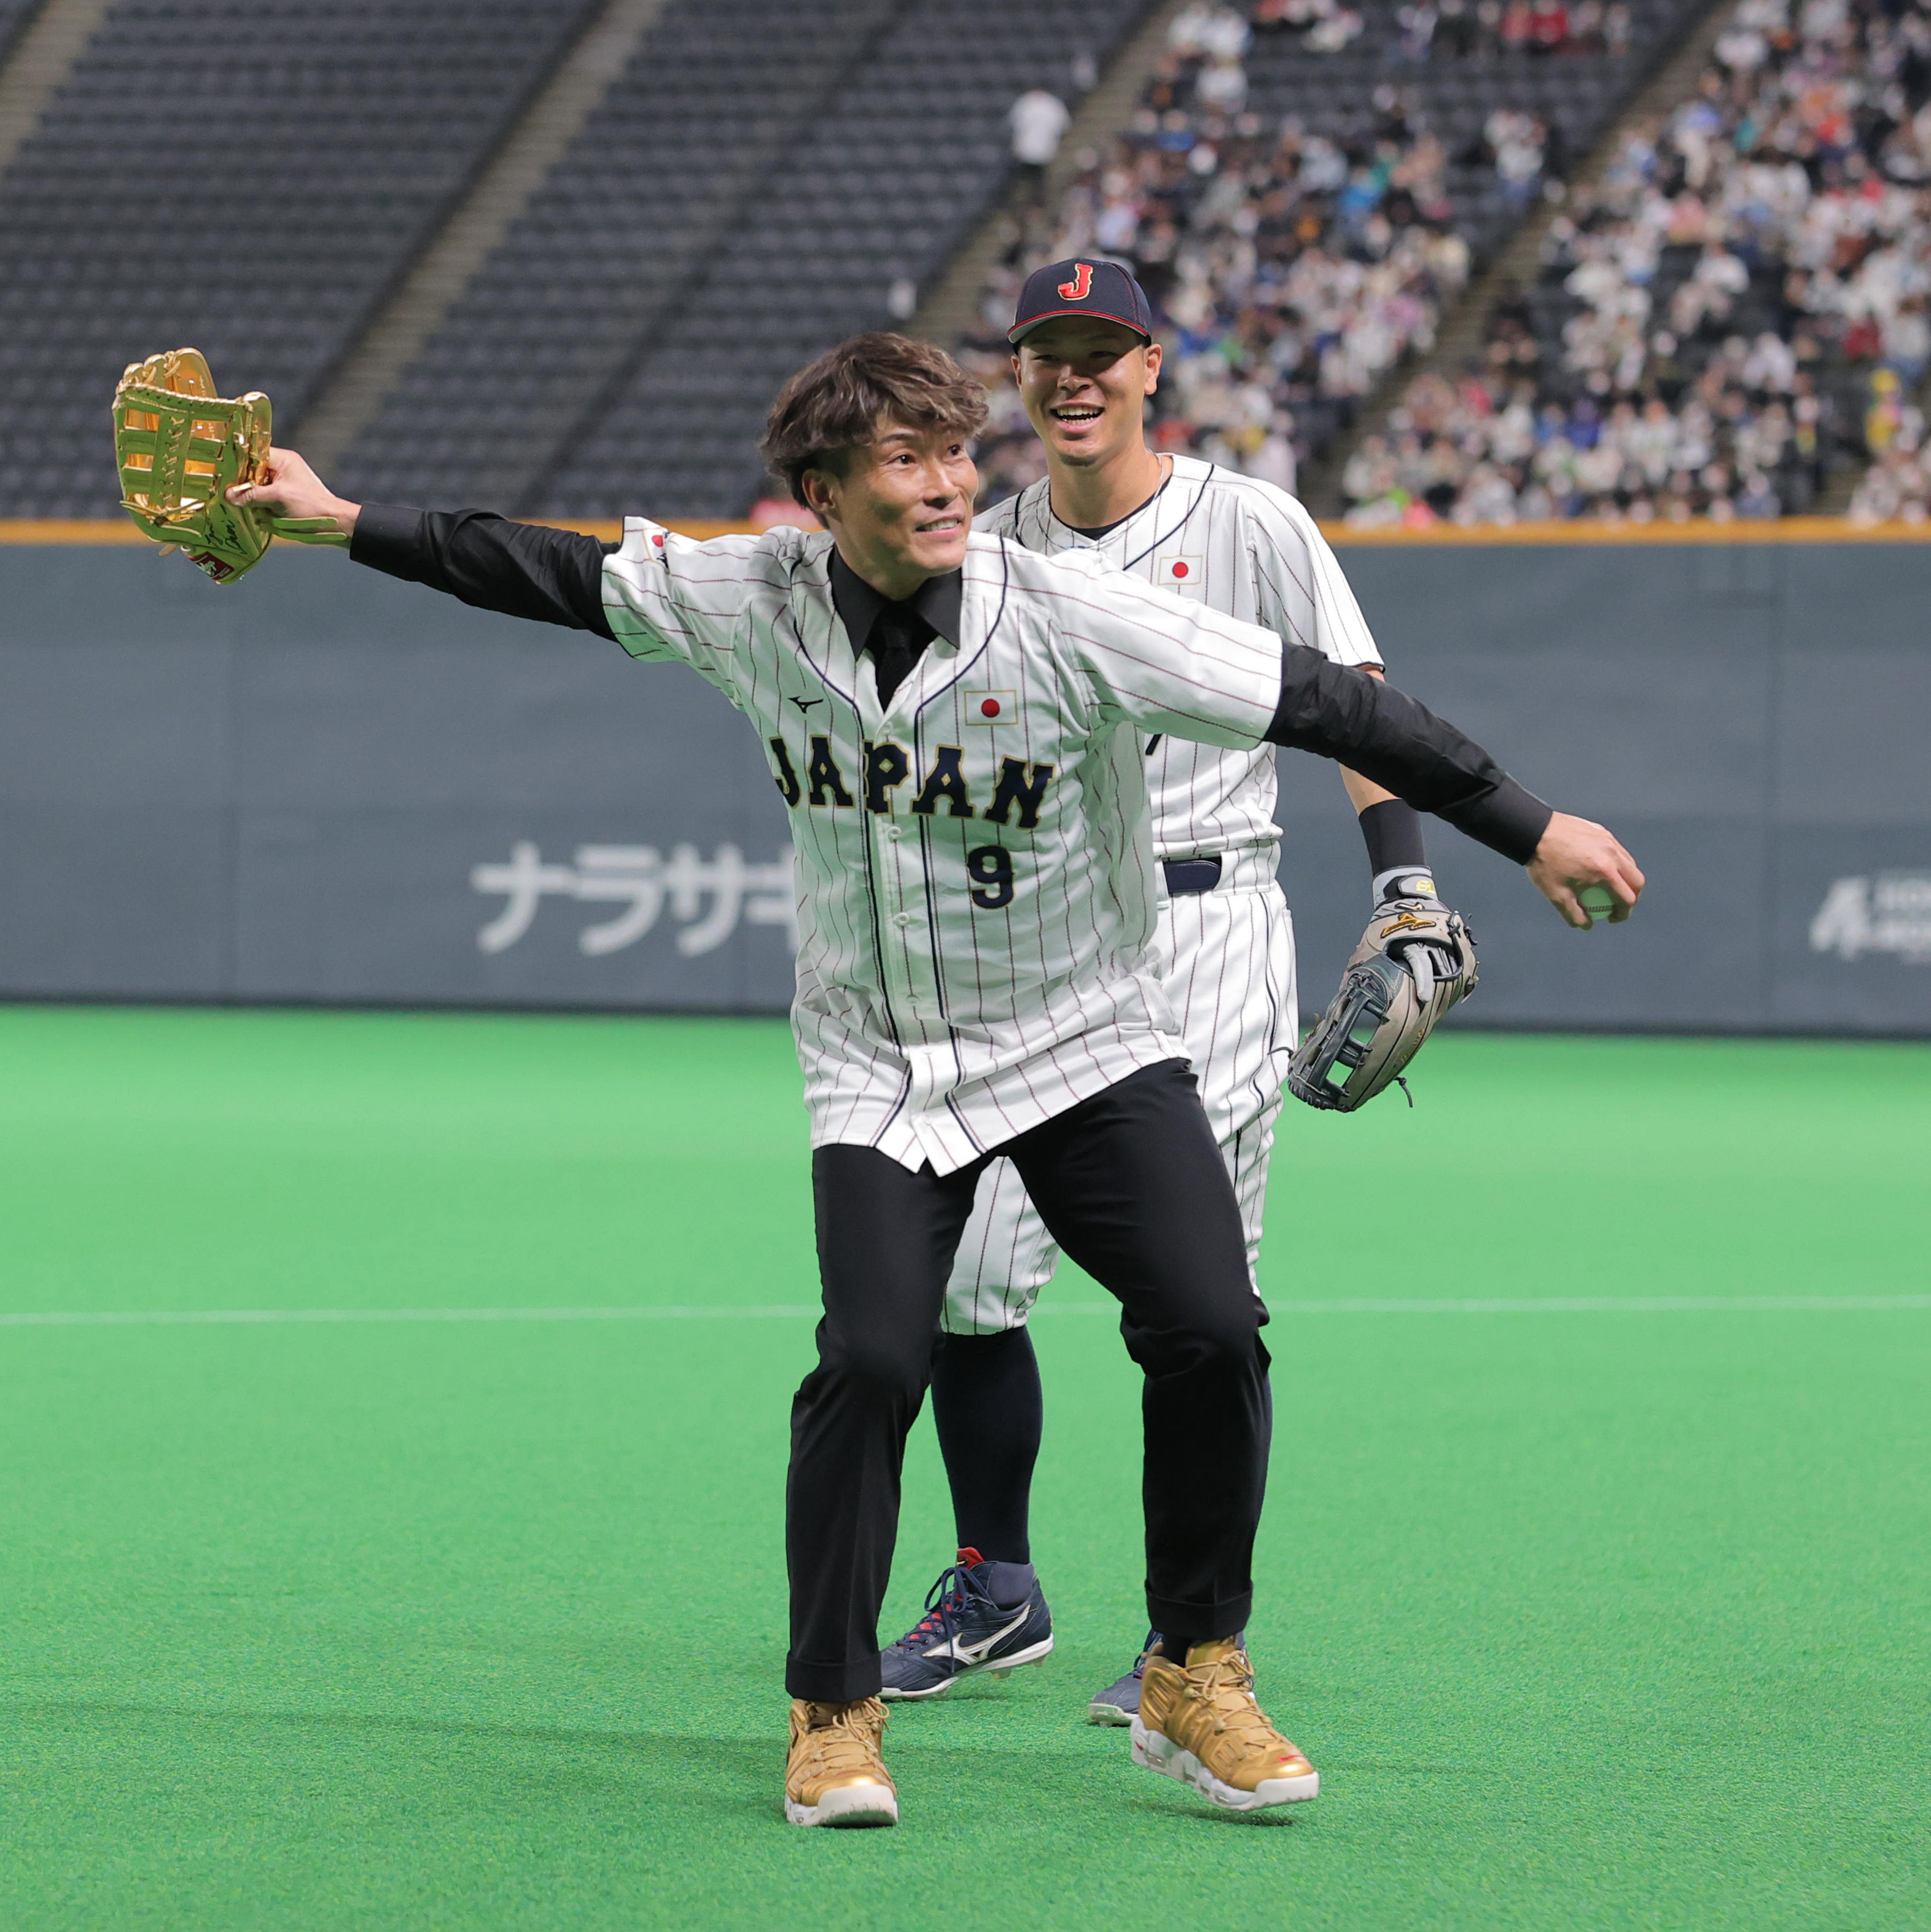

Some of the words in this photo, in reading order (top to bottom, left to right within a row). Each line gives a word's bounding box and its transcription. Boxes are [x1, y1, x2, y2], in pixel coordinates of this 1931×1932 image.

[1058, 263, 1093, 300] J
[768, 734, 1056, 831] JAPAN
[966, 844, 1015, 910] 9
